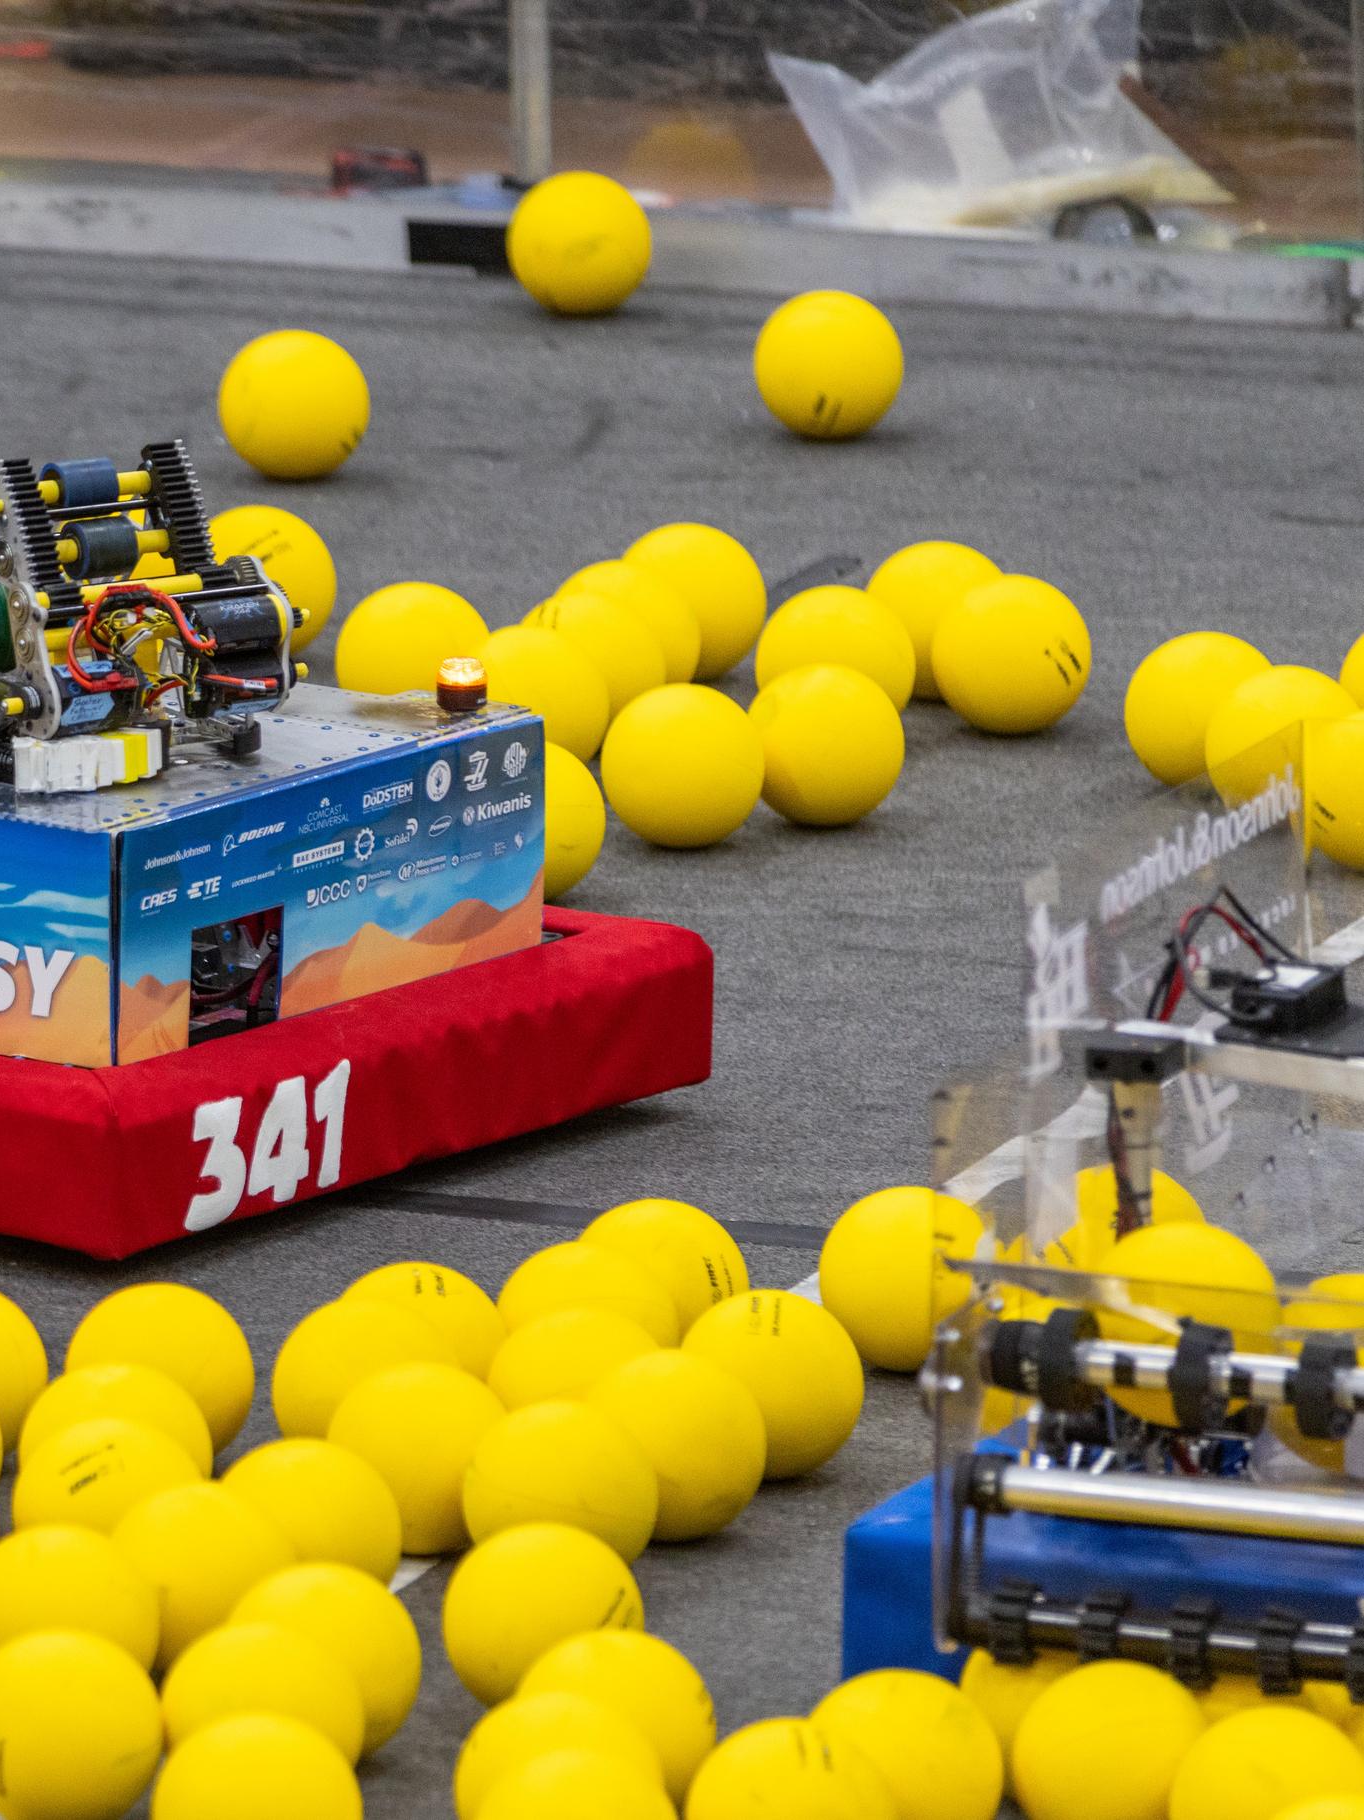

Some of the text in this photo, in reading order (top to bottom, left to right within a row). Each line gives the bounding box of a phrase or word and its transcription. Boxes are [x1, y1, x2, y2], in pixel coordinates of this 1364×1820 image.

[307, 804, 343, 823] COMCAST
[477, 792, 532, 820] Kiwanis
[238, 821, 287, 844] BOEING
[384, 832, 411, 848] Sofidel
[144, 844, 211, 870] Johnson&Johnson
[296, 844, 342, 864] BAE SYSTEMS
[183, 1058, 351, 1232] 341
